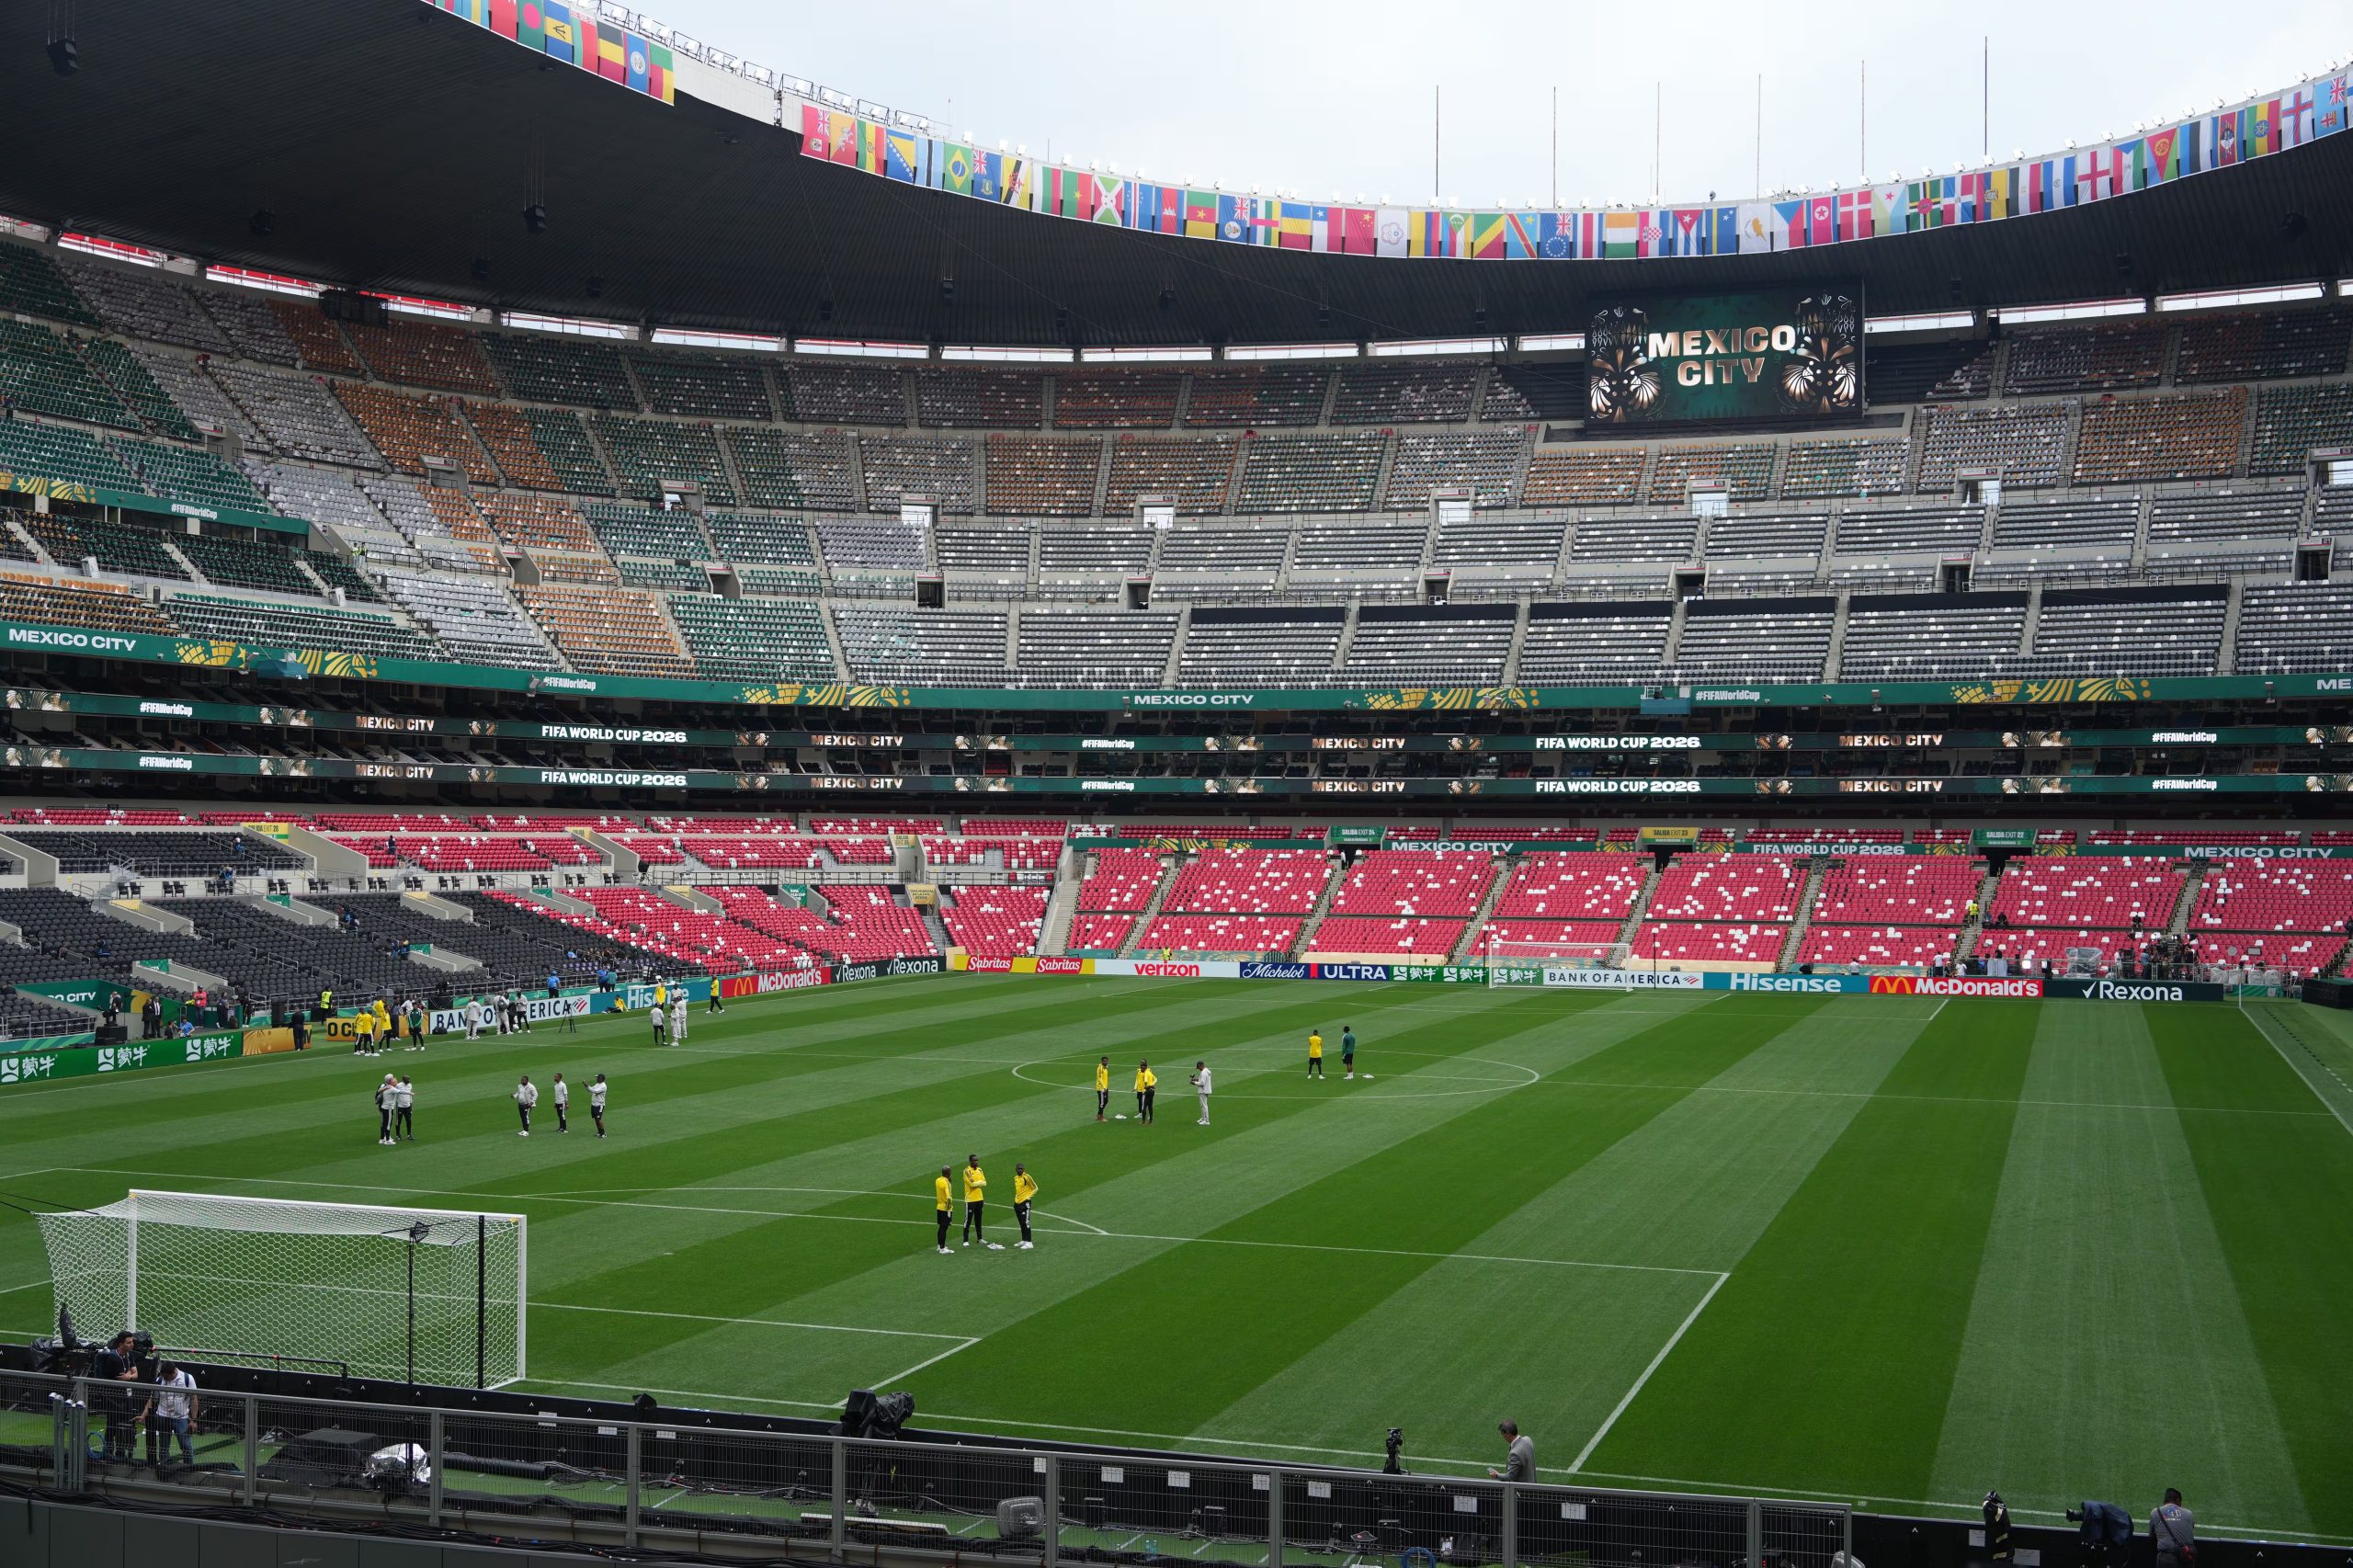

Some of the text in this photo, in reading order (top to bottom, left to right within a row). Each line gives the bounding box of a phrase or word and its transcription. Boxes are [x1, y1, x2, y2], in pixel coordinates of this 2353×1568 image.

[1648, 324, 1796, 358] MEXICO
[1677, 357, 1765, 385] CITY
[171, 504, 217, 519] #FIFAWorldCup
[9, 629, 136, 651] MEXICO CITY
[1134, 695, 1254, 704] MEXICO CITY
[1696, 690, 1760, 701] #FIFAWorldCup
[140, 702, 192, 717] #FIFAWorldCup
[356, 716, 435, 732] MEXICO CITY
[542, 726, 686, 742] FIFA WORLD CUP 2026
[811, 735, 903, 747] MEXICO CITY
[1839, 735, 1942, 746] MEXICO CITY
[2153, 733, 2216, 743] #FIFAWorldCup
[1082, 740, 1134, 749] #FIFAWorldCup
[1313, 738, 1404, 749] MEXICO CITY
[1537, 737, 1699, 748] FIFA WORLD CUP 2026
[140, 756, 192, 770] #FIFAWorldCup
[356, 764, 435, 778] MEXICO CITY
[542, 770, 686, 786] FIFA WORLD CUP 2026
[811, 778, 903, 789] MEXICO CITY
[1082, 781, 1134, 790] #FIFAWorldCup
[1313, 781, 1404, 792] MEXICO CITY
[1537, 781, 1699, 792] FIFA WORLD CUP 2026
[1839, 781, 1942, 792] MEXICO CITY
[2153, 779, 2217, 790] #FIFAWorldCup
[1392, 842, 1514, 852] MEXICO CITY
[1754, 845, 1905, 856] FIFA WORLD CUP 2026
[2185, 846, 2333, 858] MEXICO CITY
[893, 958, 938, 973] Rexona
[968, 957, 1011, 971] Sabritas
[1037, 958, 1080, 972] Sabritas
[1134, 963, 1199, 976] verizon
[1242, 962, 1386, 980] Michelob ULTRA
[757, 967, 822, 992] McDonald's
[842, 964, 876, 982] Rexona
[1410, 966, 1436, 982] 蒙牛
[1550, 972, 1681, 985] BANK OF AMERICA
[1731, 973, 1841, 992] Hisense
[1915, 979, 2039, 995] McDonald's
[67, 992, 96, 1002] CITY
[2099, 981, 2183, 1001] Rexona
[204, 1038, 232, 1057] 蒙牛
[118, 1047, 147, 1068] 蒙牛
[22, 1056, 55, 1079] 蒙牛
